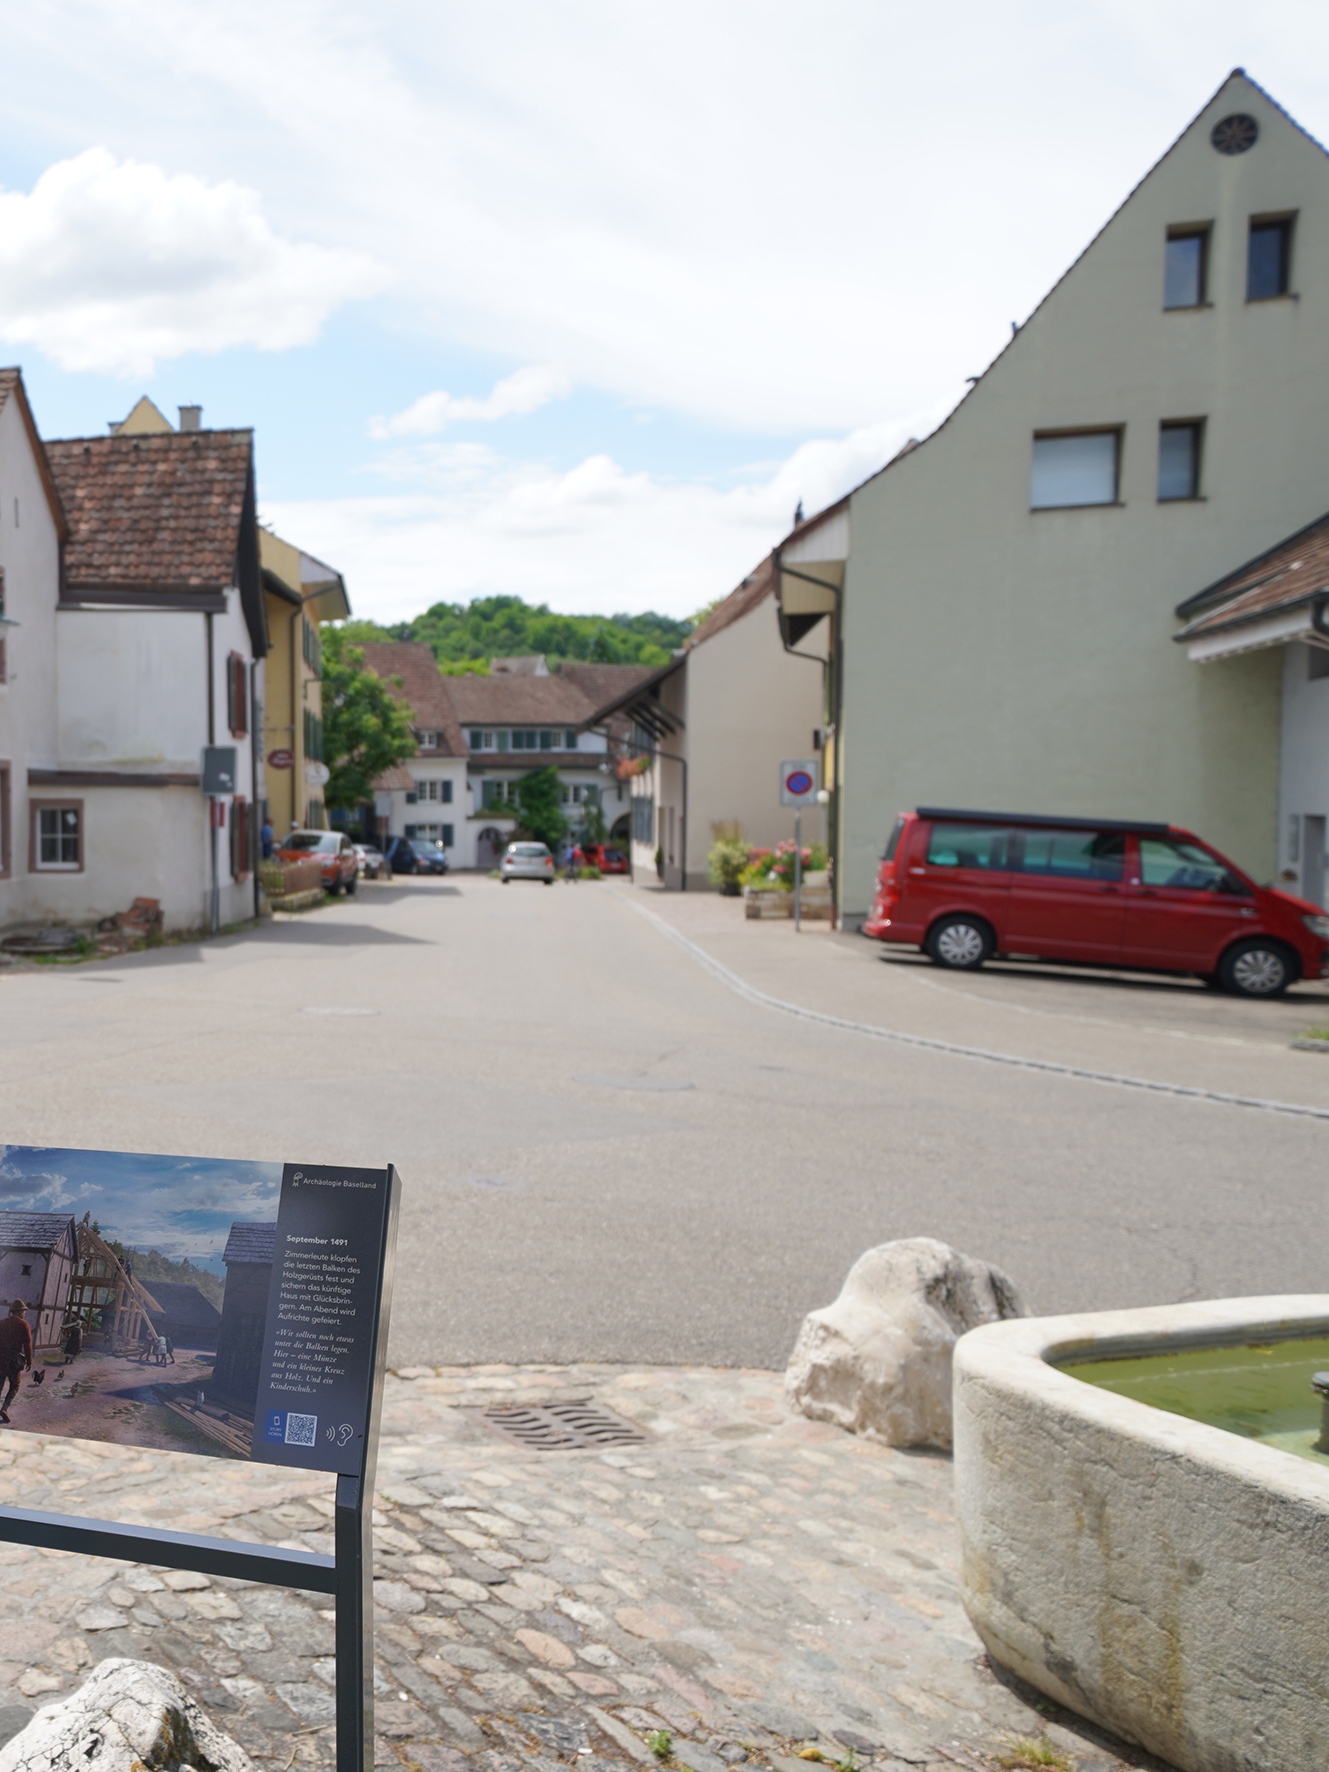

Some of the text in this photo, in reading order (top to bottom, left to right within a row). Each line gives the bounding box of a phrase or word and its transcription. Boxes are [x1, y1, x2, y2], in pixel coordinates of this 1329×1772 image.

[303, 1178, 376, 1189] Archäologie Baselland
[287, 1235, 328, 1244] September
[285, 1250, 357, 1263] Zimmerleute klopfen
[297, 1262, 320, 1270] letzten
[322, 1264, 345, 1272] Balken
[347, 1266, 360, 1274] des
[283, 1271, 323, 1281] Holzgerüsts
[326, 1274, 338, 1282] fest
[322, 1285, 351, 1295] künftige
[313, 1294, 352, 1304] Glücksbrin-
[314, 1305, 338, 1314] Abend
[278, 1313, 341, 1325] Aufrichte gefeiert.
[296, 1331, 316, 1339] sollten
[306, 1342, 328, 1351] Balken
[331, 1345, 349, 1354] legen.
[313, 1354, 337, 1363] Münze
[299, 1363, 322, 1372] kleines
[325, 1366, 345, 1375] Kreuz
[285, 1373, 303, 1381] Holz.
[307, 1375, 321, 1383] Und
[270, 1382, 316, 1393] Kinderschuh.»
